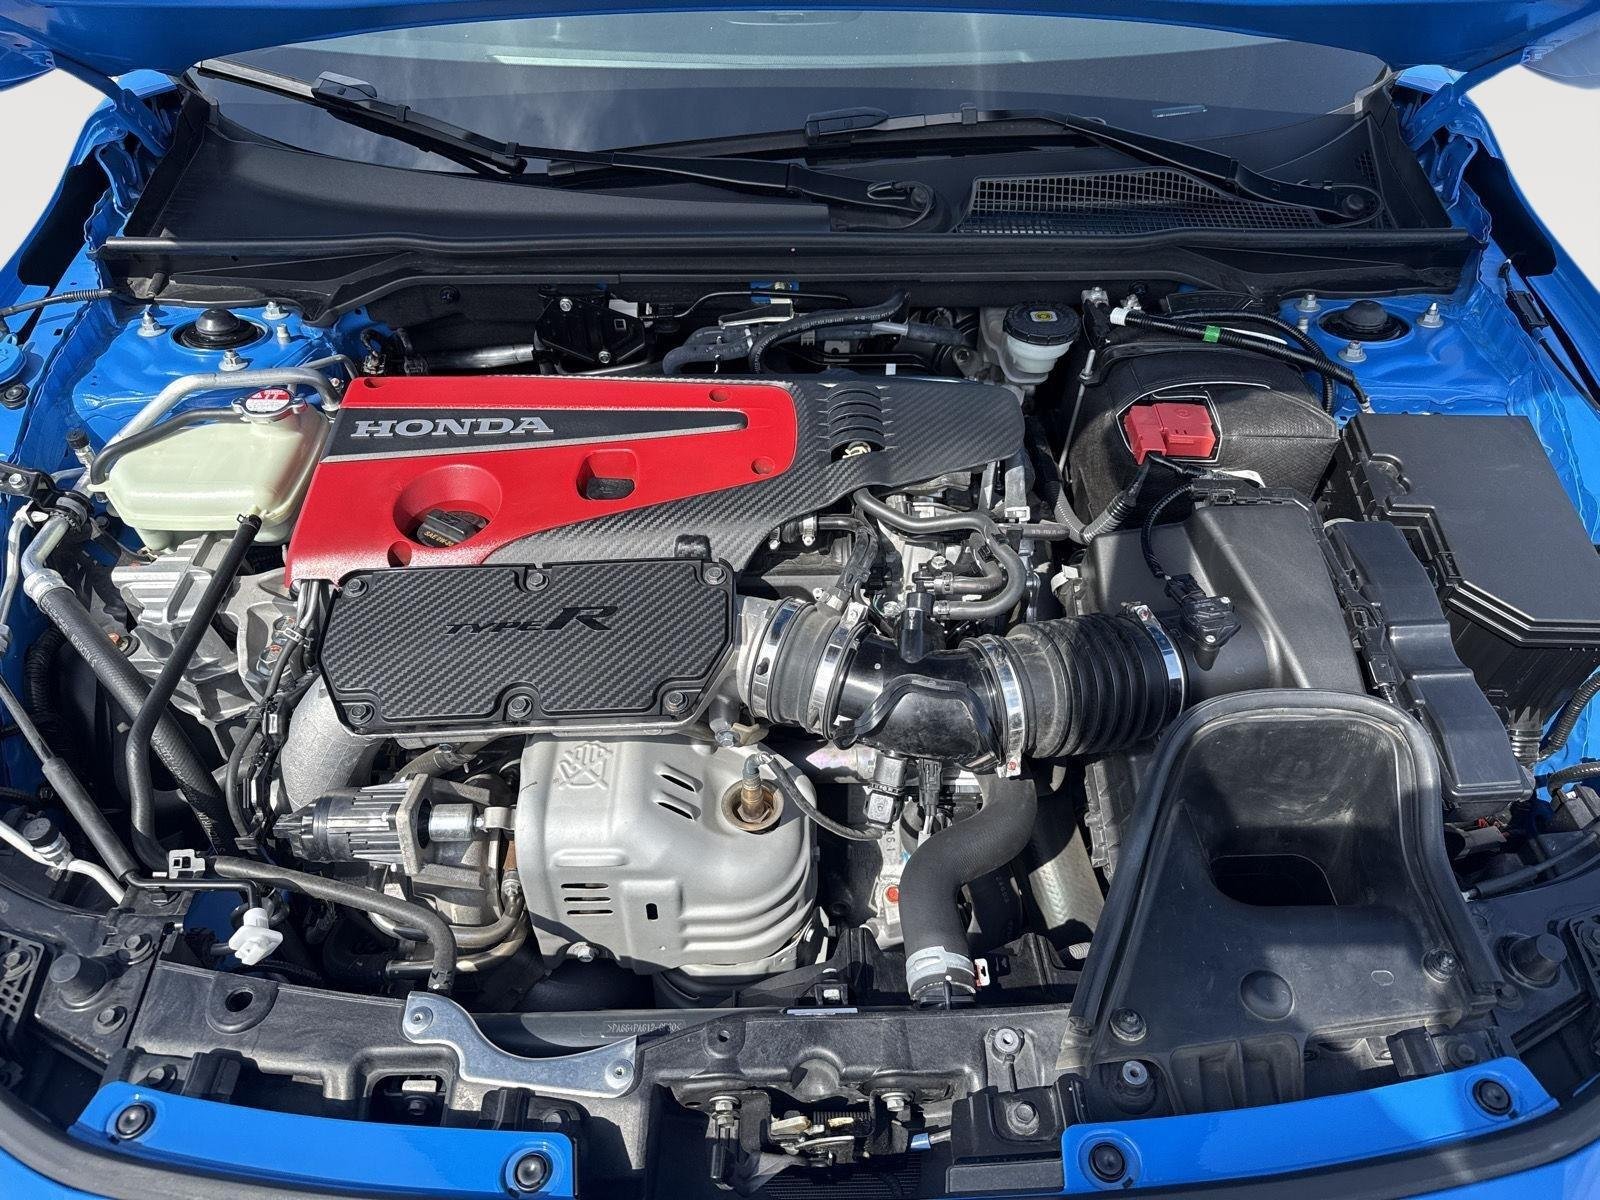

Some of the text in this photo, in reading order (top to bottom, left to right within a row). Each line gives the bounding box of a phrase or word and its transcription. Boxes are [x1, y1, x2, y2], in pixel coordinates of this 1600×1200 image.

[350, 416, 554, 437] HONDA
[424, 530, 438, 540] SAE
[445, 605, 619, 635] TYPE R
